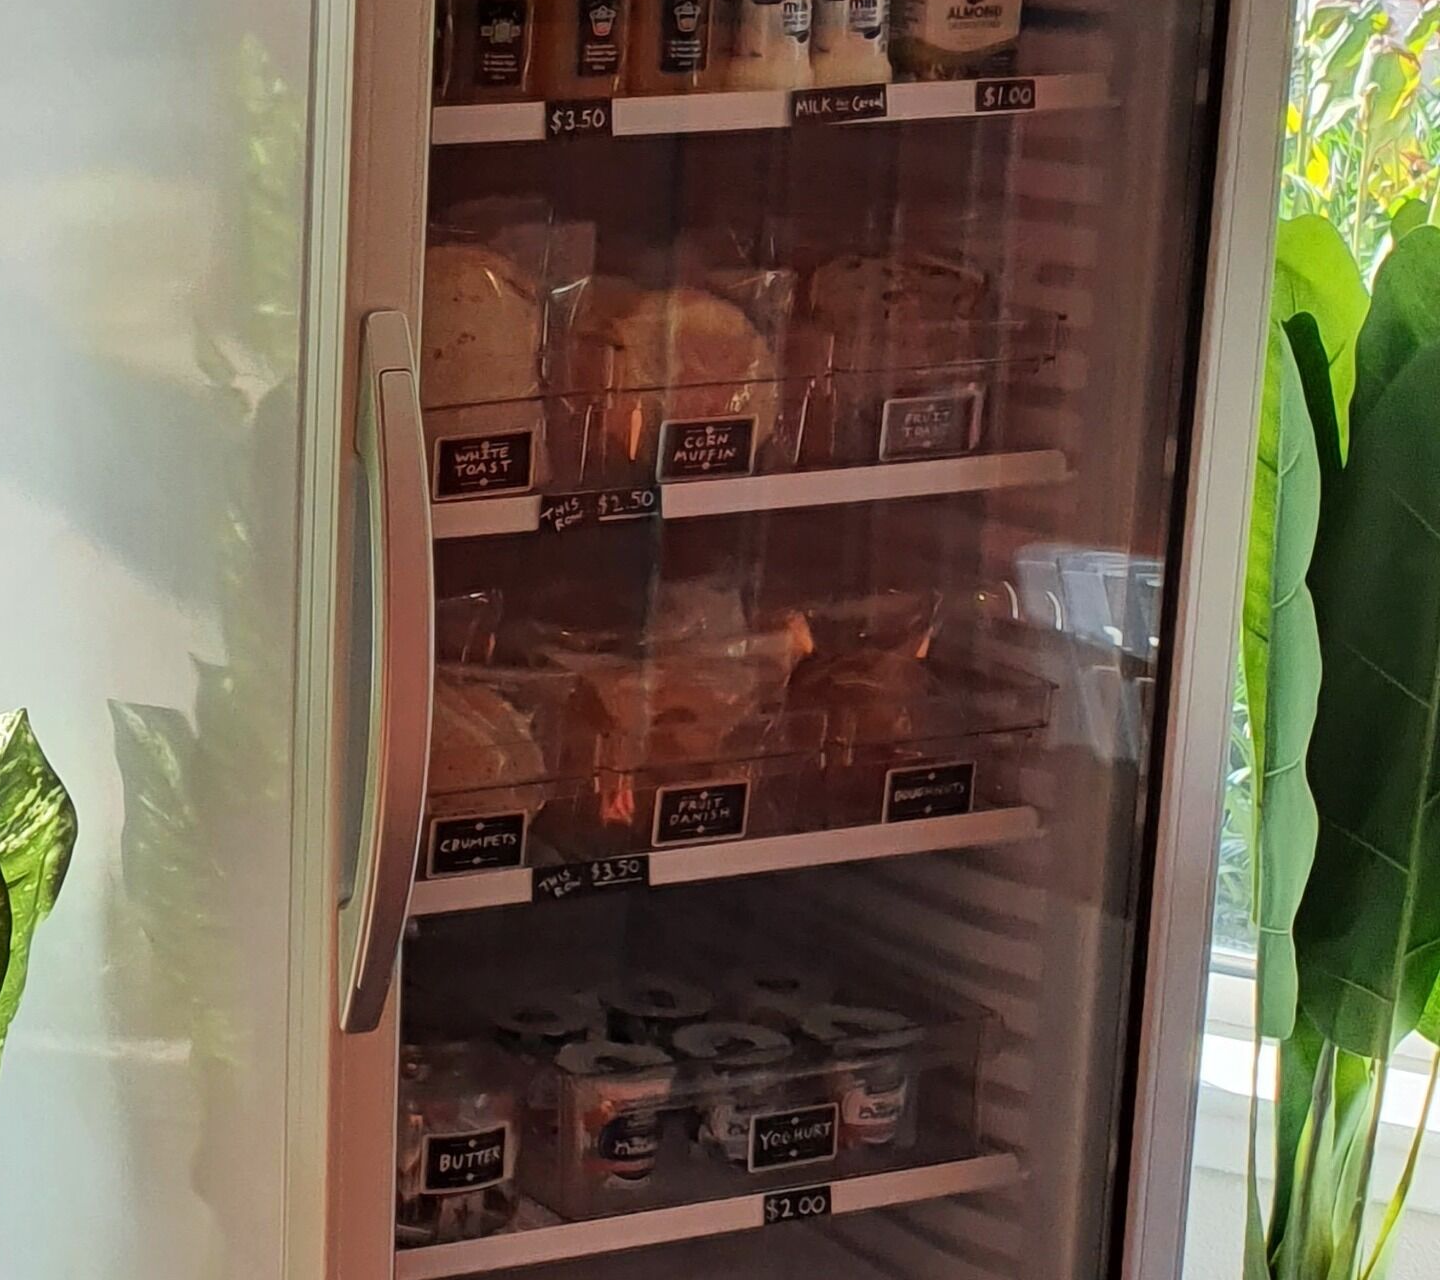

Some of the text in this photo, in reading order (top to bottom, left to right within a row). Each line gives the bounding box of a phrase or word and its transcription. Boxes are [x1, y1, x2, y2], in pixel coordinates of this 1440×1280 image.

[946, 5, 1003, 19] ALMOND
[795, 96, 833, 118] MILK
[550, 109, 607, 135] $3.50
[684, 430, 729, 450] CORN
[455, 445, 510, 464] WHITE
[673, 445, 737, 464] MUFFIN
[455, 458, 513, 477] TOAST
[540, 496, 580, 520] THIS
[677, 796, 725, 813] FRUIT
[669, 806, 731, 825] DANISH
[439, 831, 518, 853] CRUMPETS
[538, 859, 640, 893] THIS $3.50
[438, 1142, 501, 1174] BUTTER
